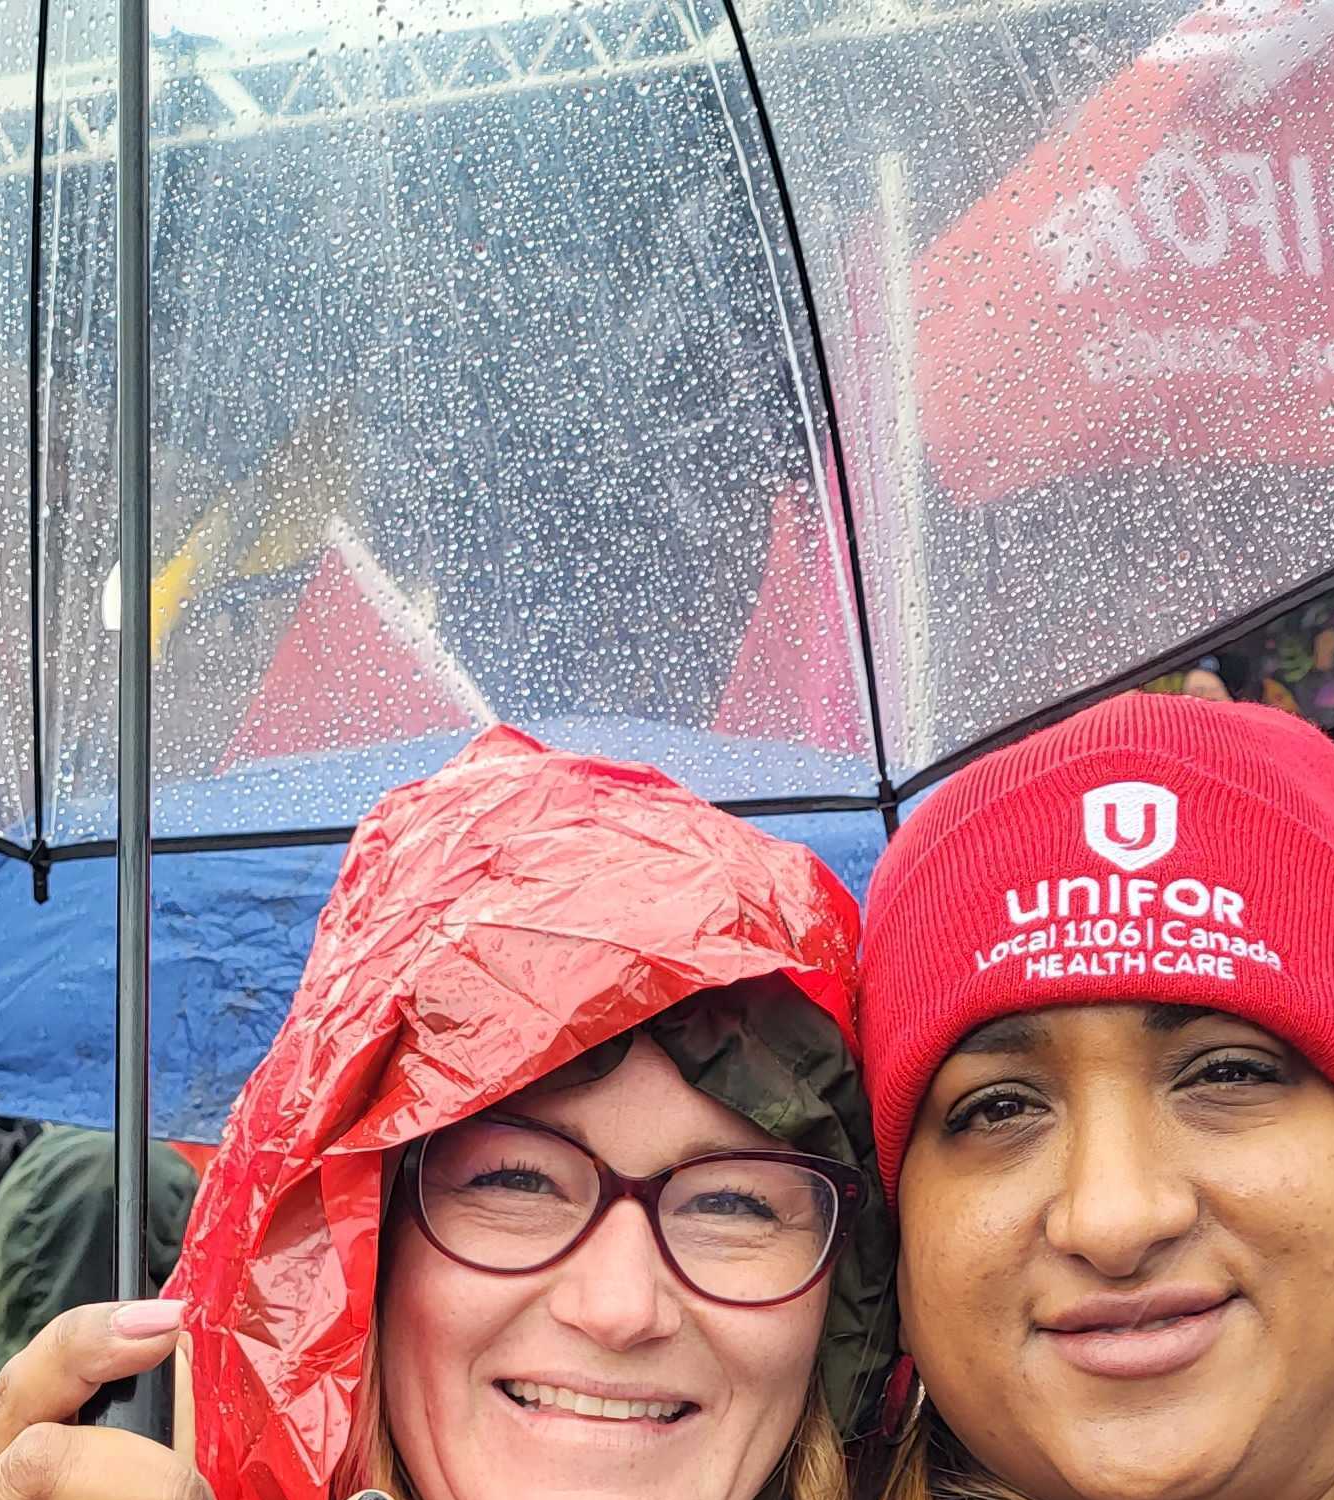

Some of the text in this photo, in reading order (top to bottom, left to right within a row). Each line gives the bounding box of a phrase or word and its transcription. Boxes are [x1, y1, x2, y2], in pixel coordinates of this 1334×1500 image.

[974, 922, 1057, 972] Local
[1063, 918, 1142, 948] 1106
[1161, 920, 1283, 972] Canada
[1025, 951, 1237, 981] HEALTH CARE
